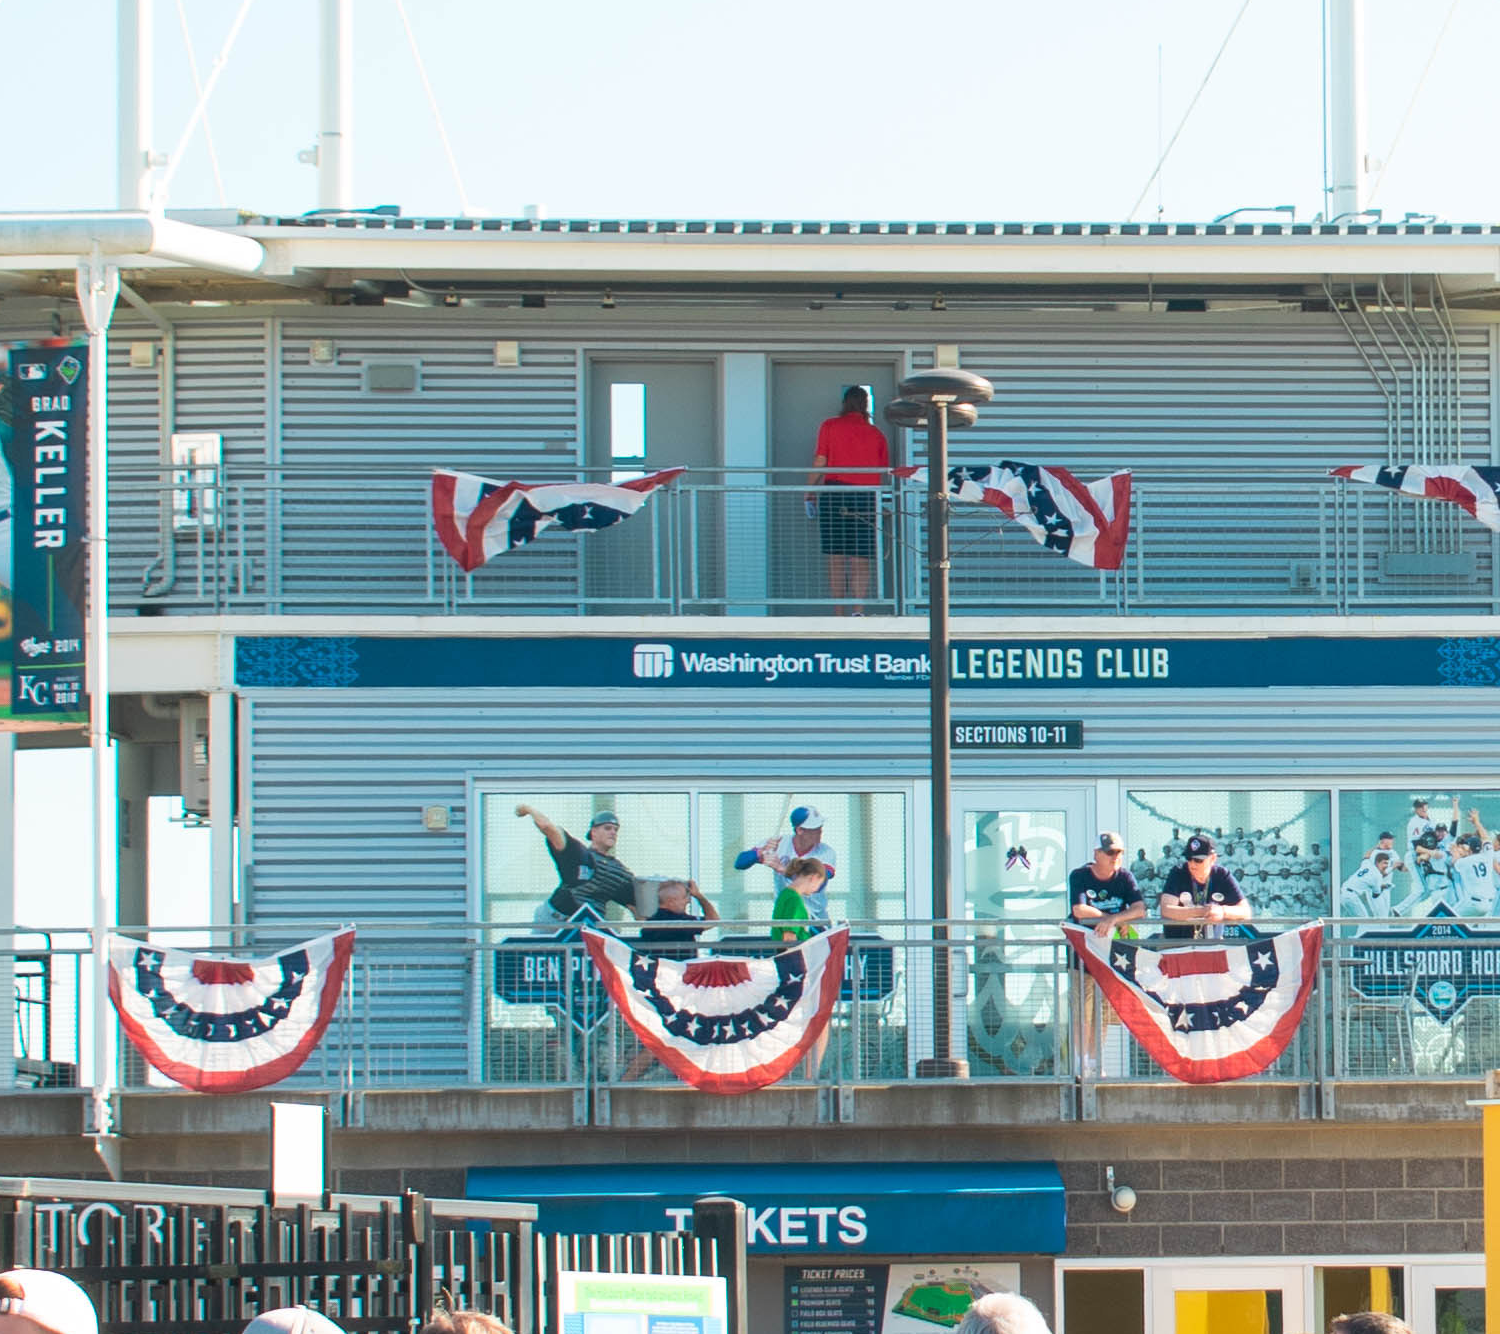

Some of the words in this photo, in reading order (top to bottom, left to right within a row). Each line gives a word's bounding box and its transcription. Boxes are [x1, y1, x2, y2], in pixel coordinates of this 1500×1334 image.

[30, 394, 71, 412] BRAD
[33, 420, 68, 549] KELLER
[680, 651, 813, 682] Washington
[814, 653, 871, 674] Trust
[875, 653, 932, 674] Bank
[951, 648, 1083, 679] LEGENDS
[1096, 648, 1170, 679] CLUB
[19, 674, 50, 706] KC
[955, 726, 1028, 744] SECTIONS
[1030, 726, 1068, 744] 10-11
[1472, 862, 1488, 878] 19
[1219, 925, 1240, 938] 936
[1431, 924, 1452, 936] 2014
[523, 955, 560, 983] BEN
[1364, 950, 1463, 976] HILLSBORO
[665, 1205, 868, 1245] TKETS
[803, 1269, 831, 1279] TICKET
[834, 1268, 865, 1279] PRICES
